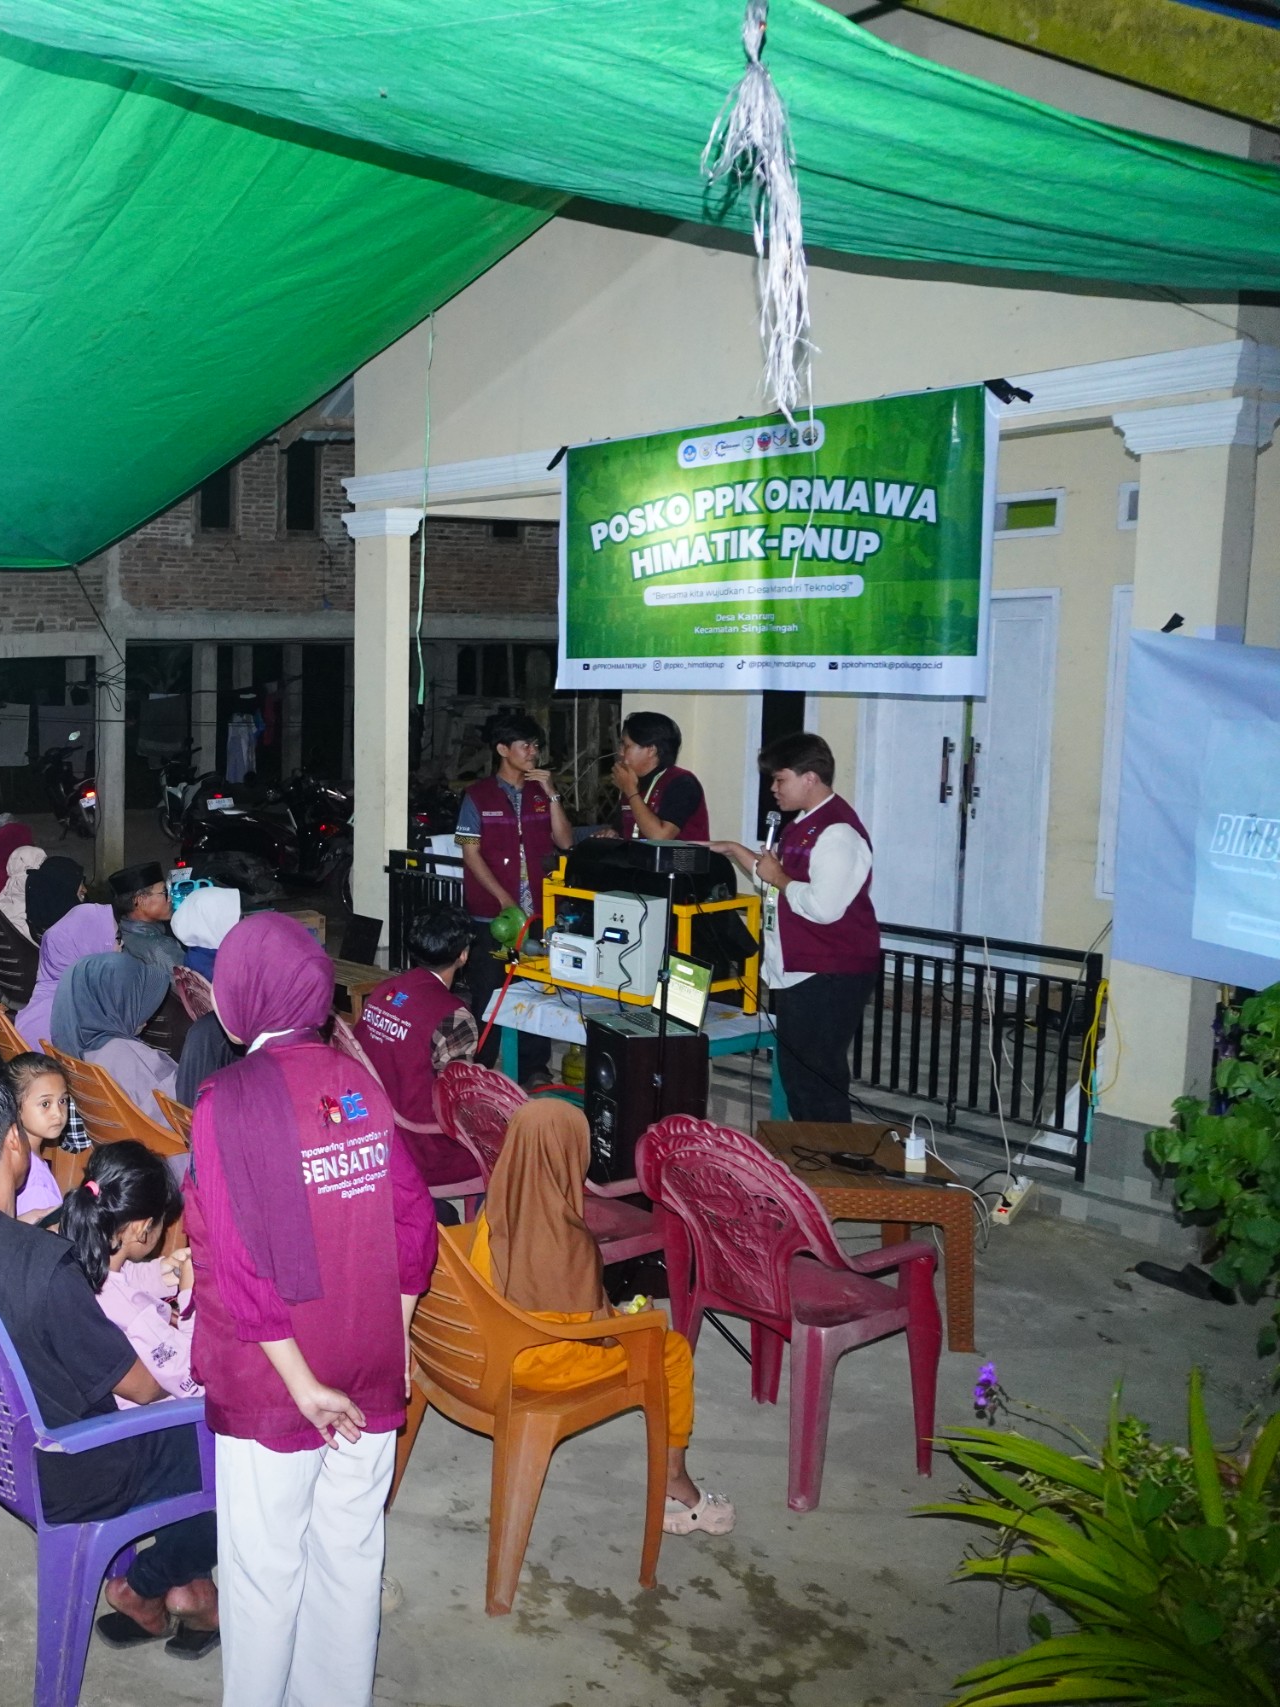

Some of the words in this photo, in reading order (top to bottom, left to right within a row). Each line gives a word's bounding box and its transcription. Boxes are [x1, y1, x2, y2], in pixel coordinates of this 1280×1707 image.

[590, 495, 691, 551] POSKO
[694, 481, 759, 521] PPK
[764, 479, 937, 523] ORMAWA
[631, 527, 881, 579] HIMATIK-PNUP
[694, 625, 739, 634] Kecamatan
[715, 613, 736, 622] Desa
[362, 1008, 408, 1041] SENSATION
